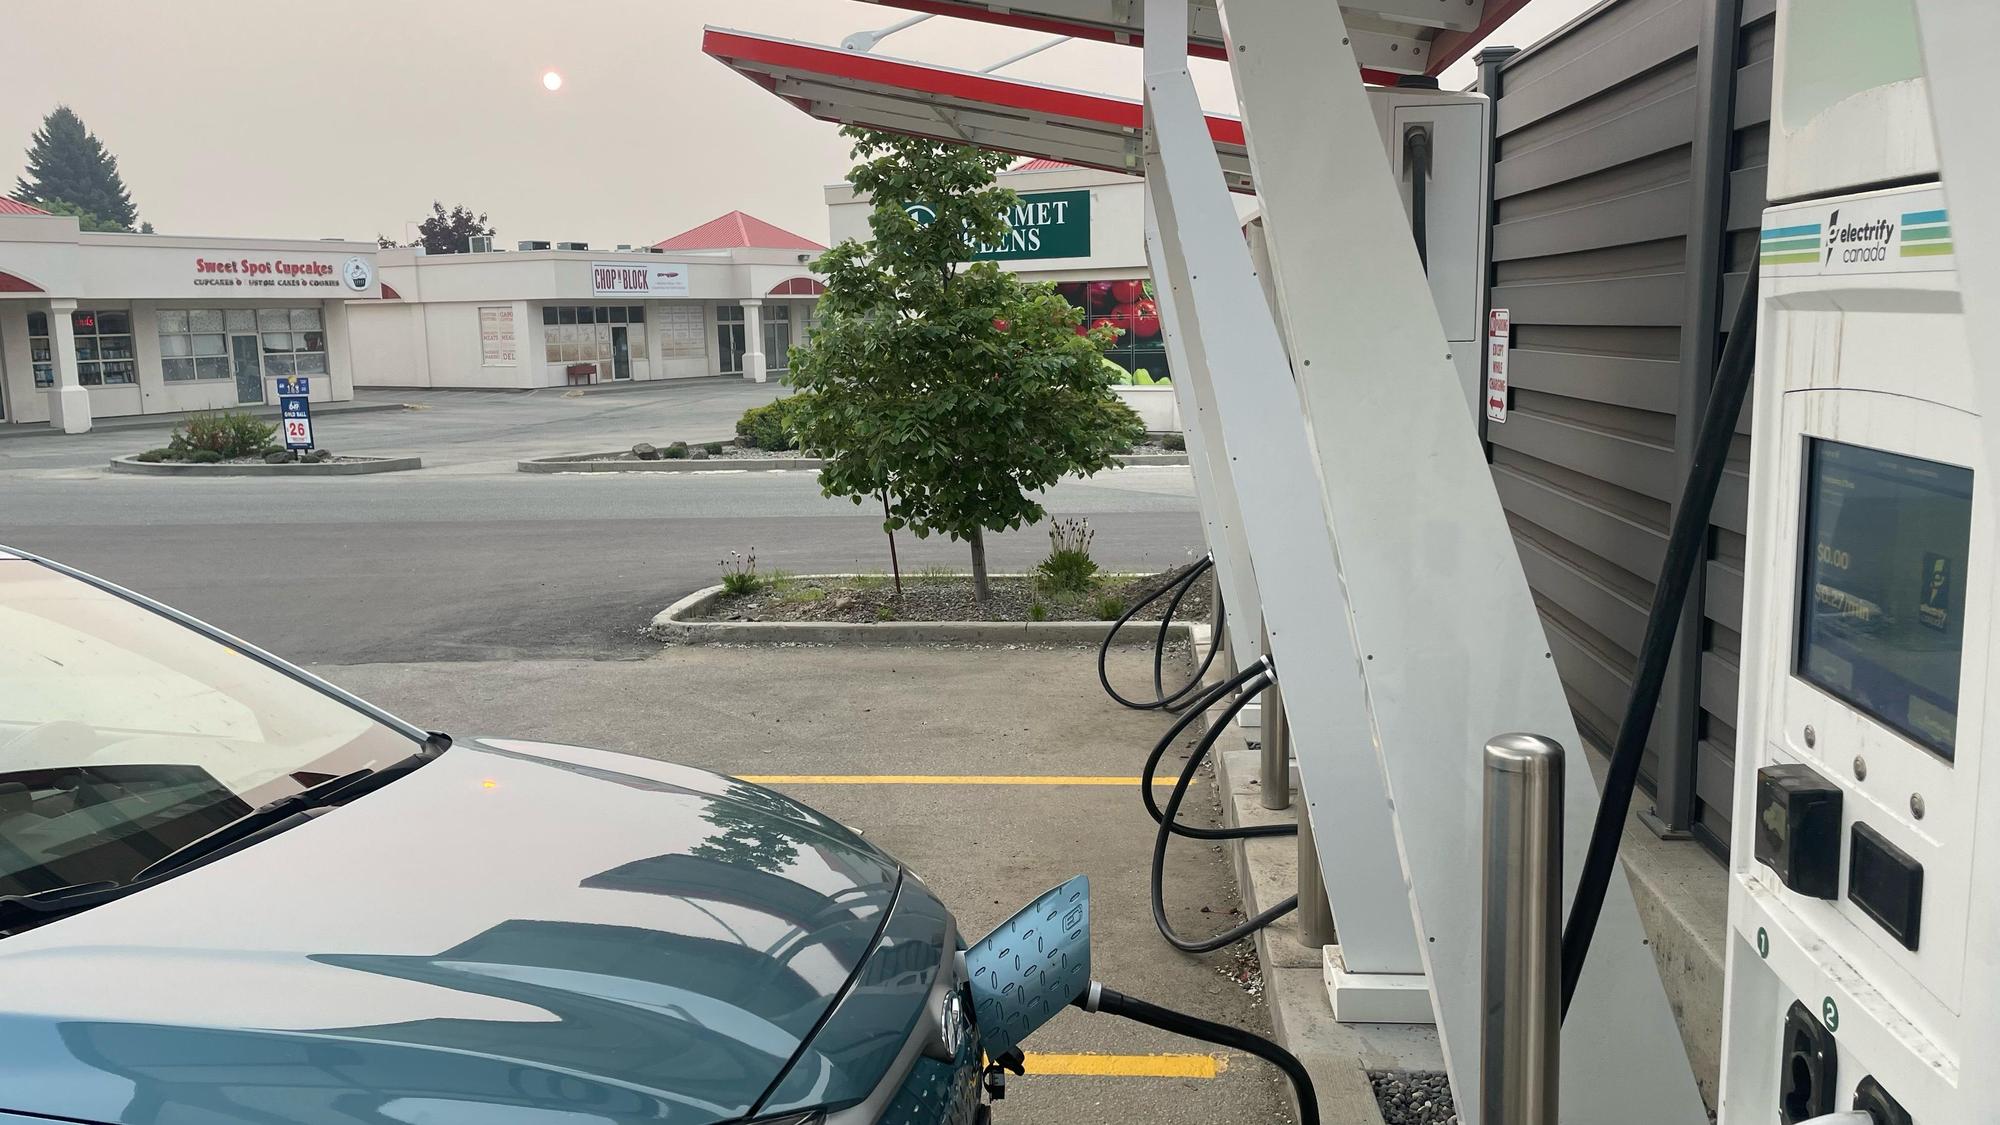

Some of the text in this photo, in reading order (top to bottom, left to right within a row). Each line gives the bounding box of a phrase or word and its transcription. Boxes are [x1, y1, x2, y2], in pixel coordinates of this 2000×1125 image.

[1840, 219, 1894, 244] electrify
[1843, 242, 1886, 263] canada
[197, 259, 237, 273] Sweet
[241, 260, 271, 276] Spot
[275, 261, 333, 276] Cupcakes
[194, 279, 234, 287] CUPCAKES
[595, 269, 616, 290] CHOP
[623, 270, 649, 290] BLOCK
[289, 422, 305, 437] 26
[1817, 543, 1849, 570] $0.00
[1760, 933, 1766, 952] 1
[1825, 1003, 1835, 1028] 2
